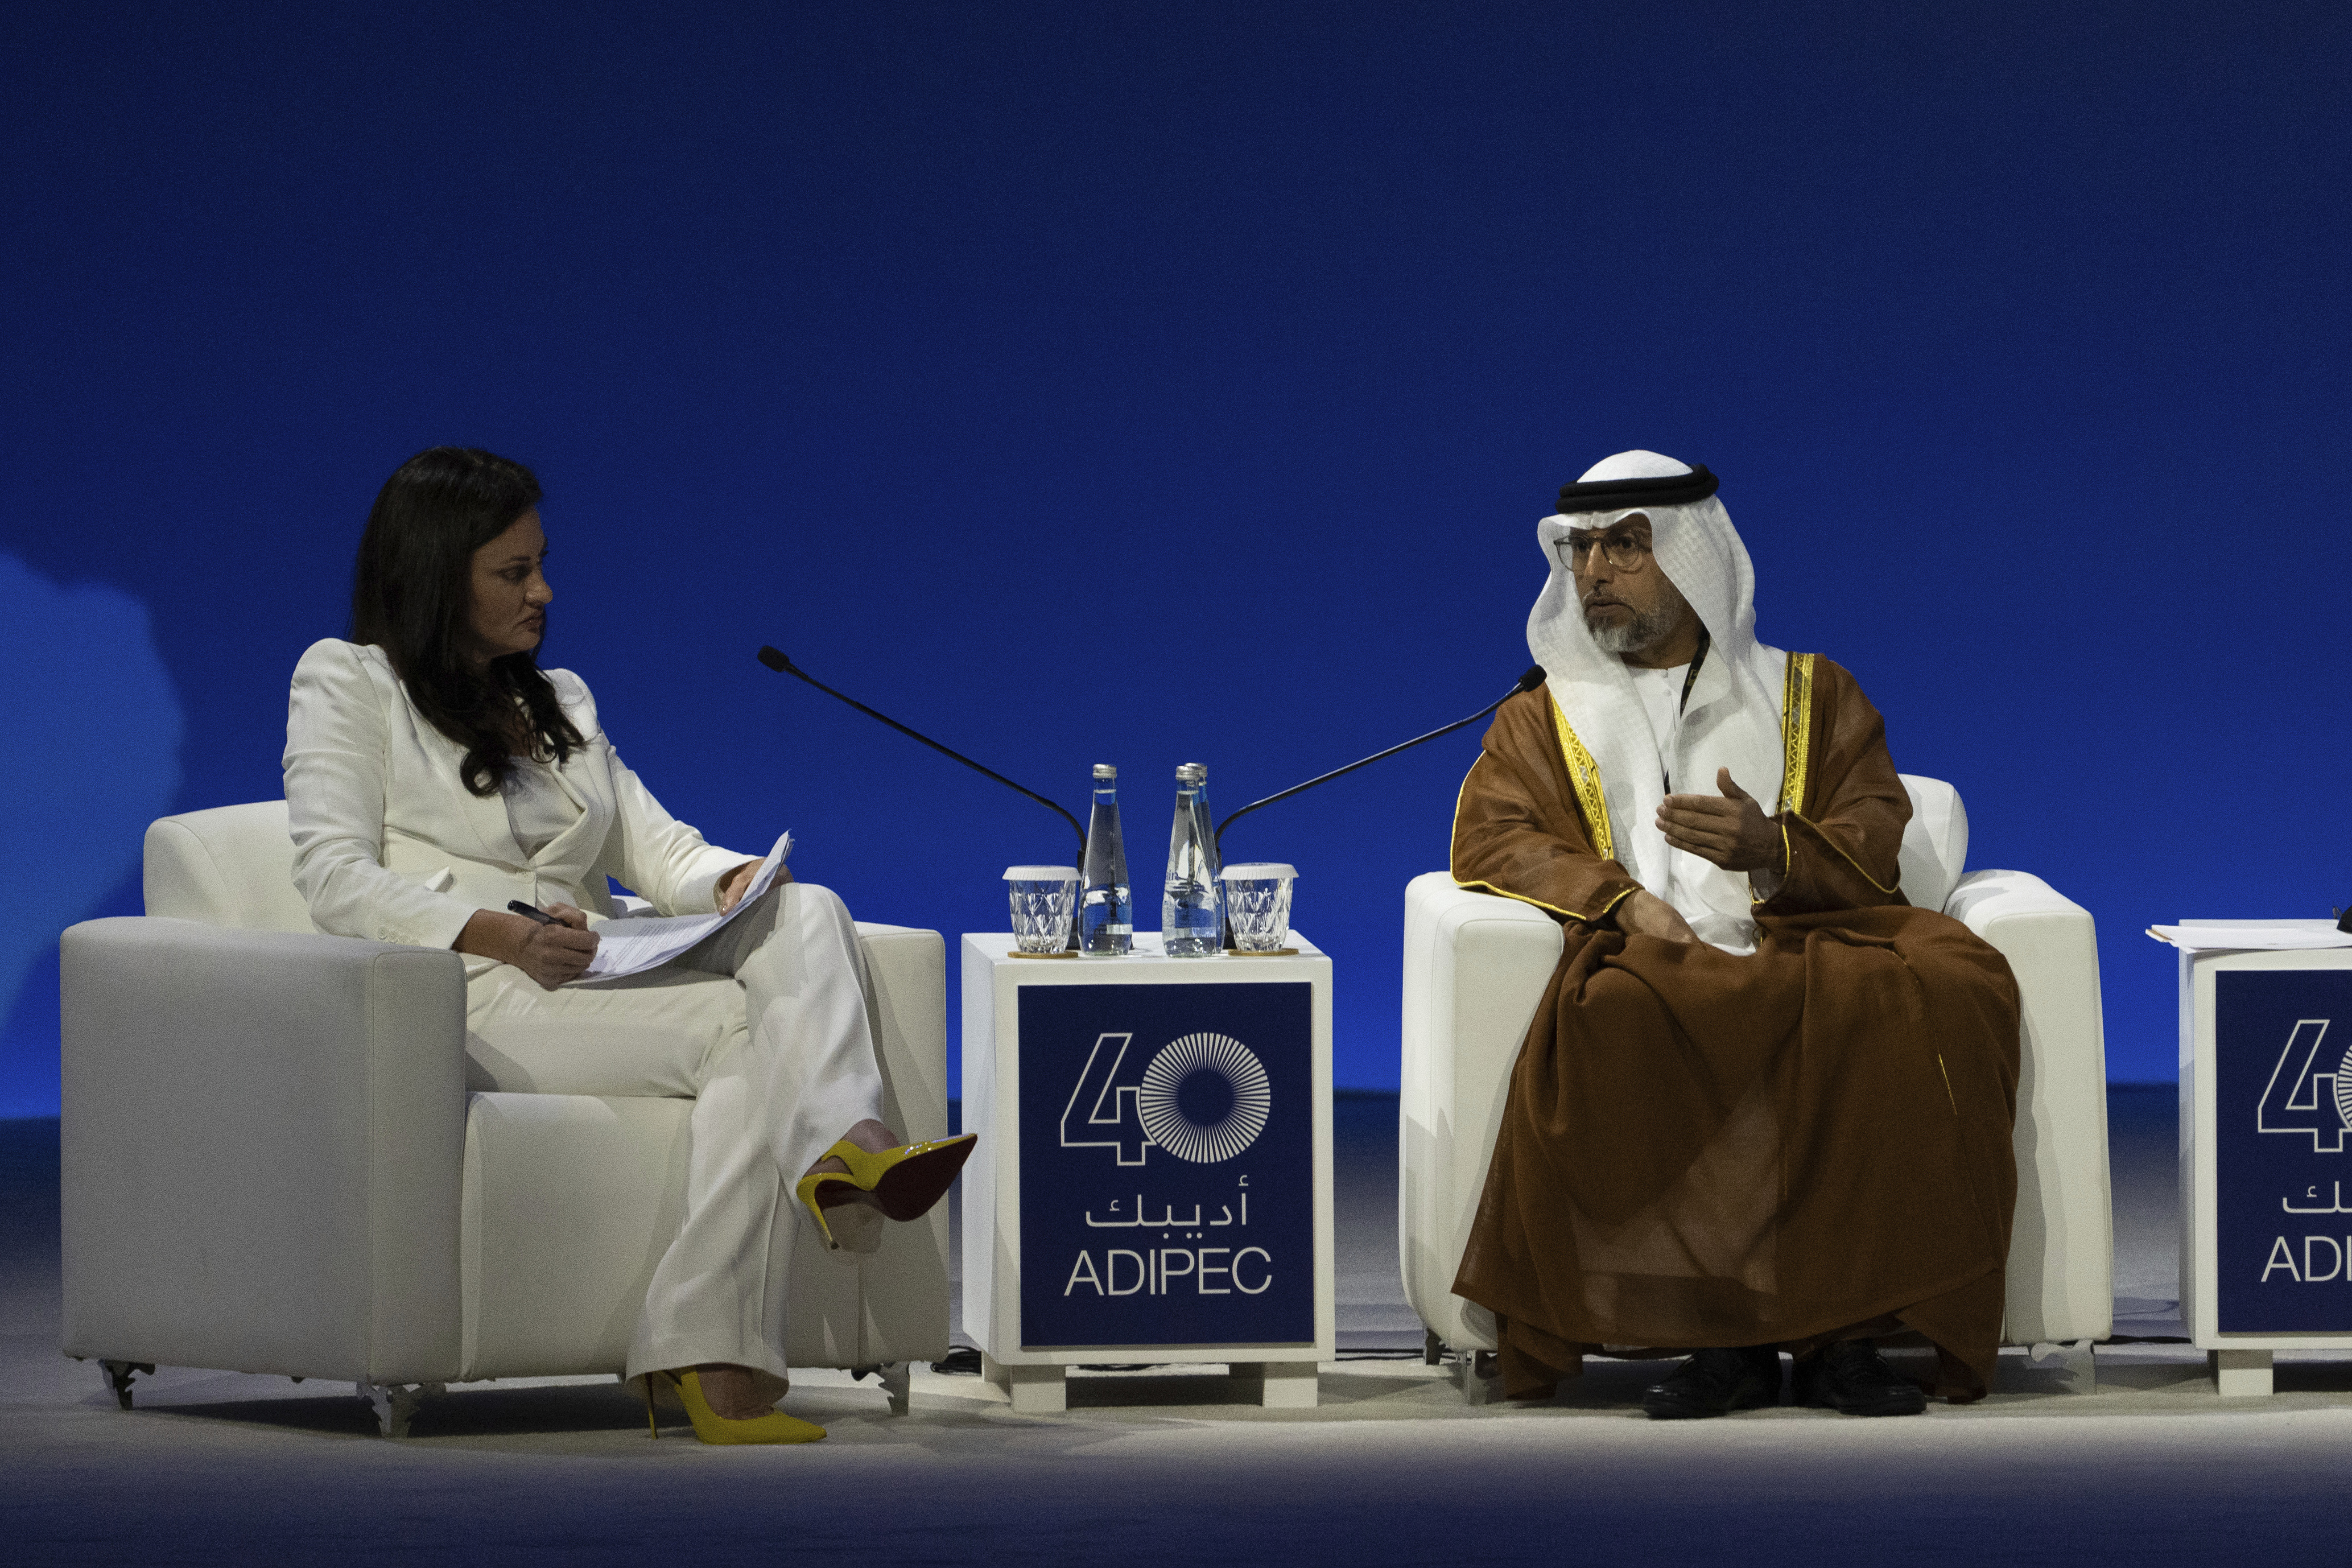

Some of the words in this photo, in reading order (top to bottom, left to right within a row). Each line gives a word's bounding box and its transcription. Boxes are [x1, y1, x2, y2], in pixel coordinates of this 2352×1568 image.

[1061, 1033, 1270, 1165] 40
[2258, 1020, 2352, 1153] 4
[1086, 1175, 1248, 1239] أديبك
[1064, 1247, 1272, 1295] ADIPEC
